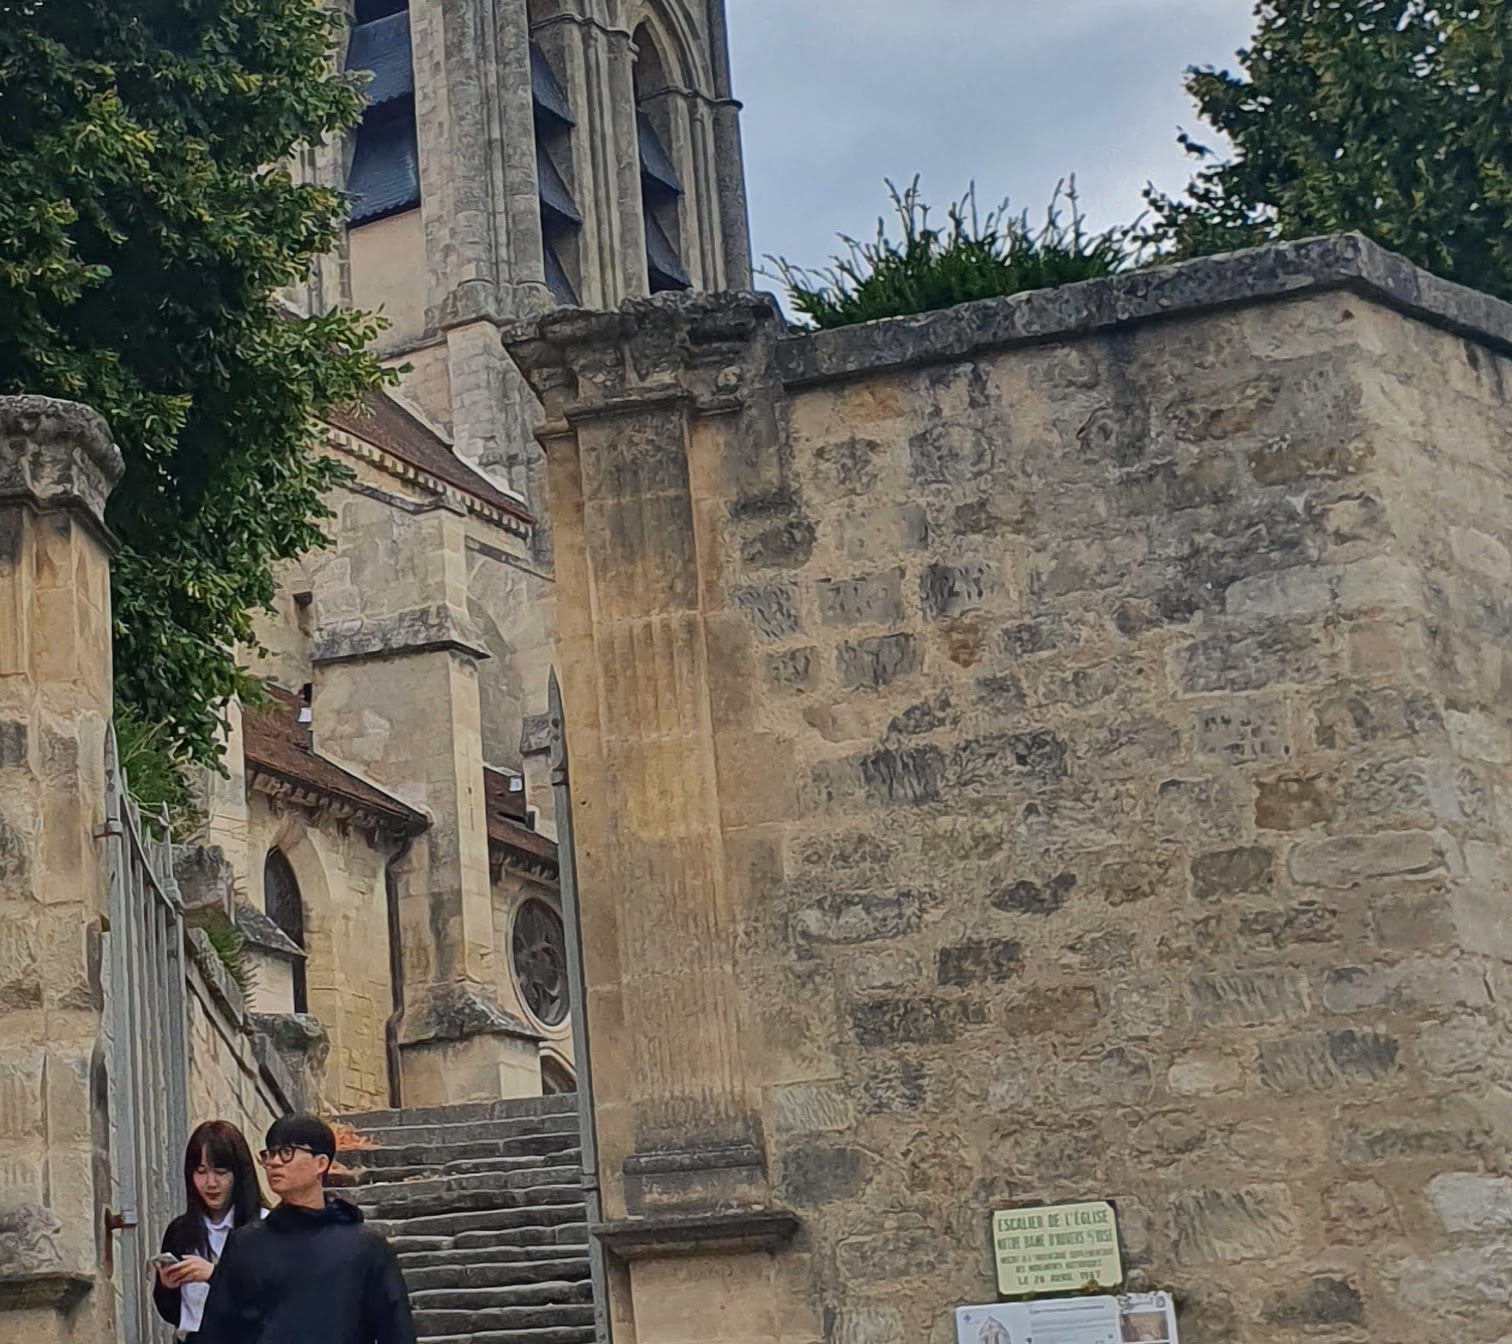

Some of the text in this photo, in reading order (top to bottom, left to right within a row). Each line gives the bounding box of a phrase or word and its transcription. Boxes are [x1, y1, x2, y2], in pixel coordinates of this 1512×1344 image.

[998, 1209, 1108, 1232] ESCALIER DE L'ÉGLISE
[1018, 1275, 1029, 1286] LE
